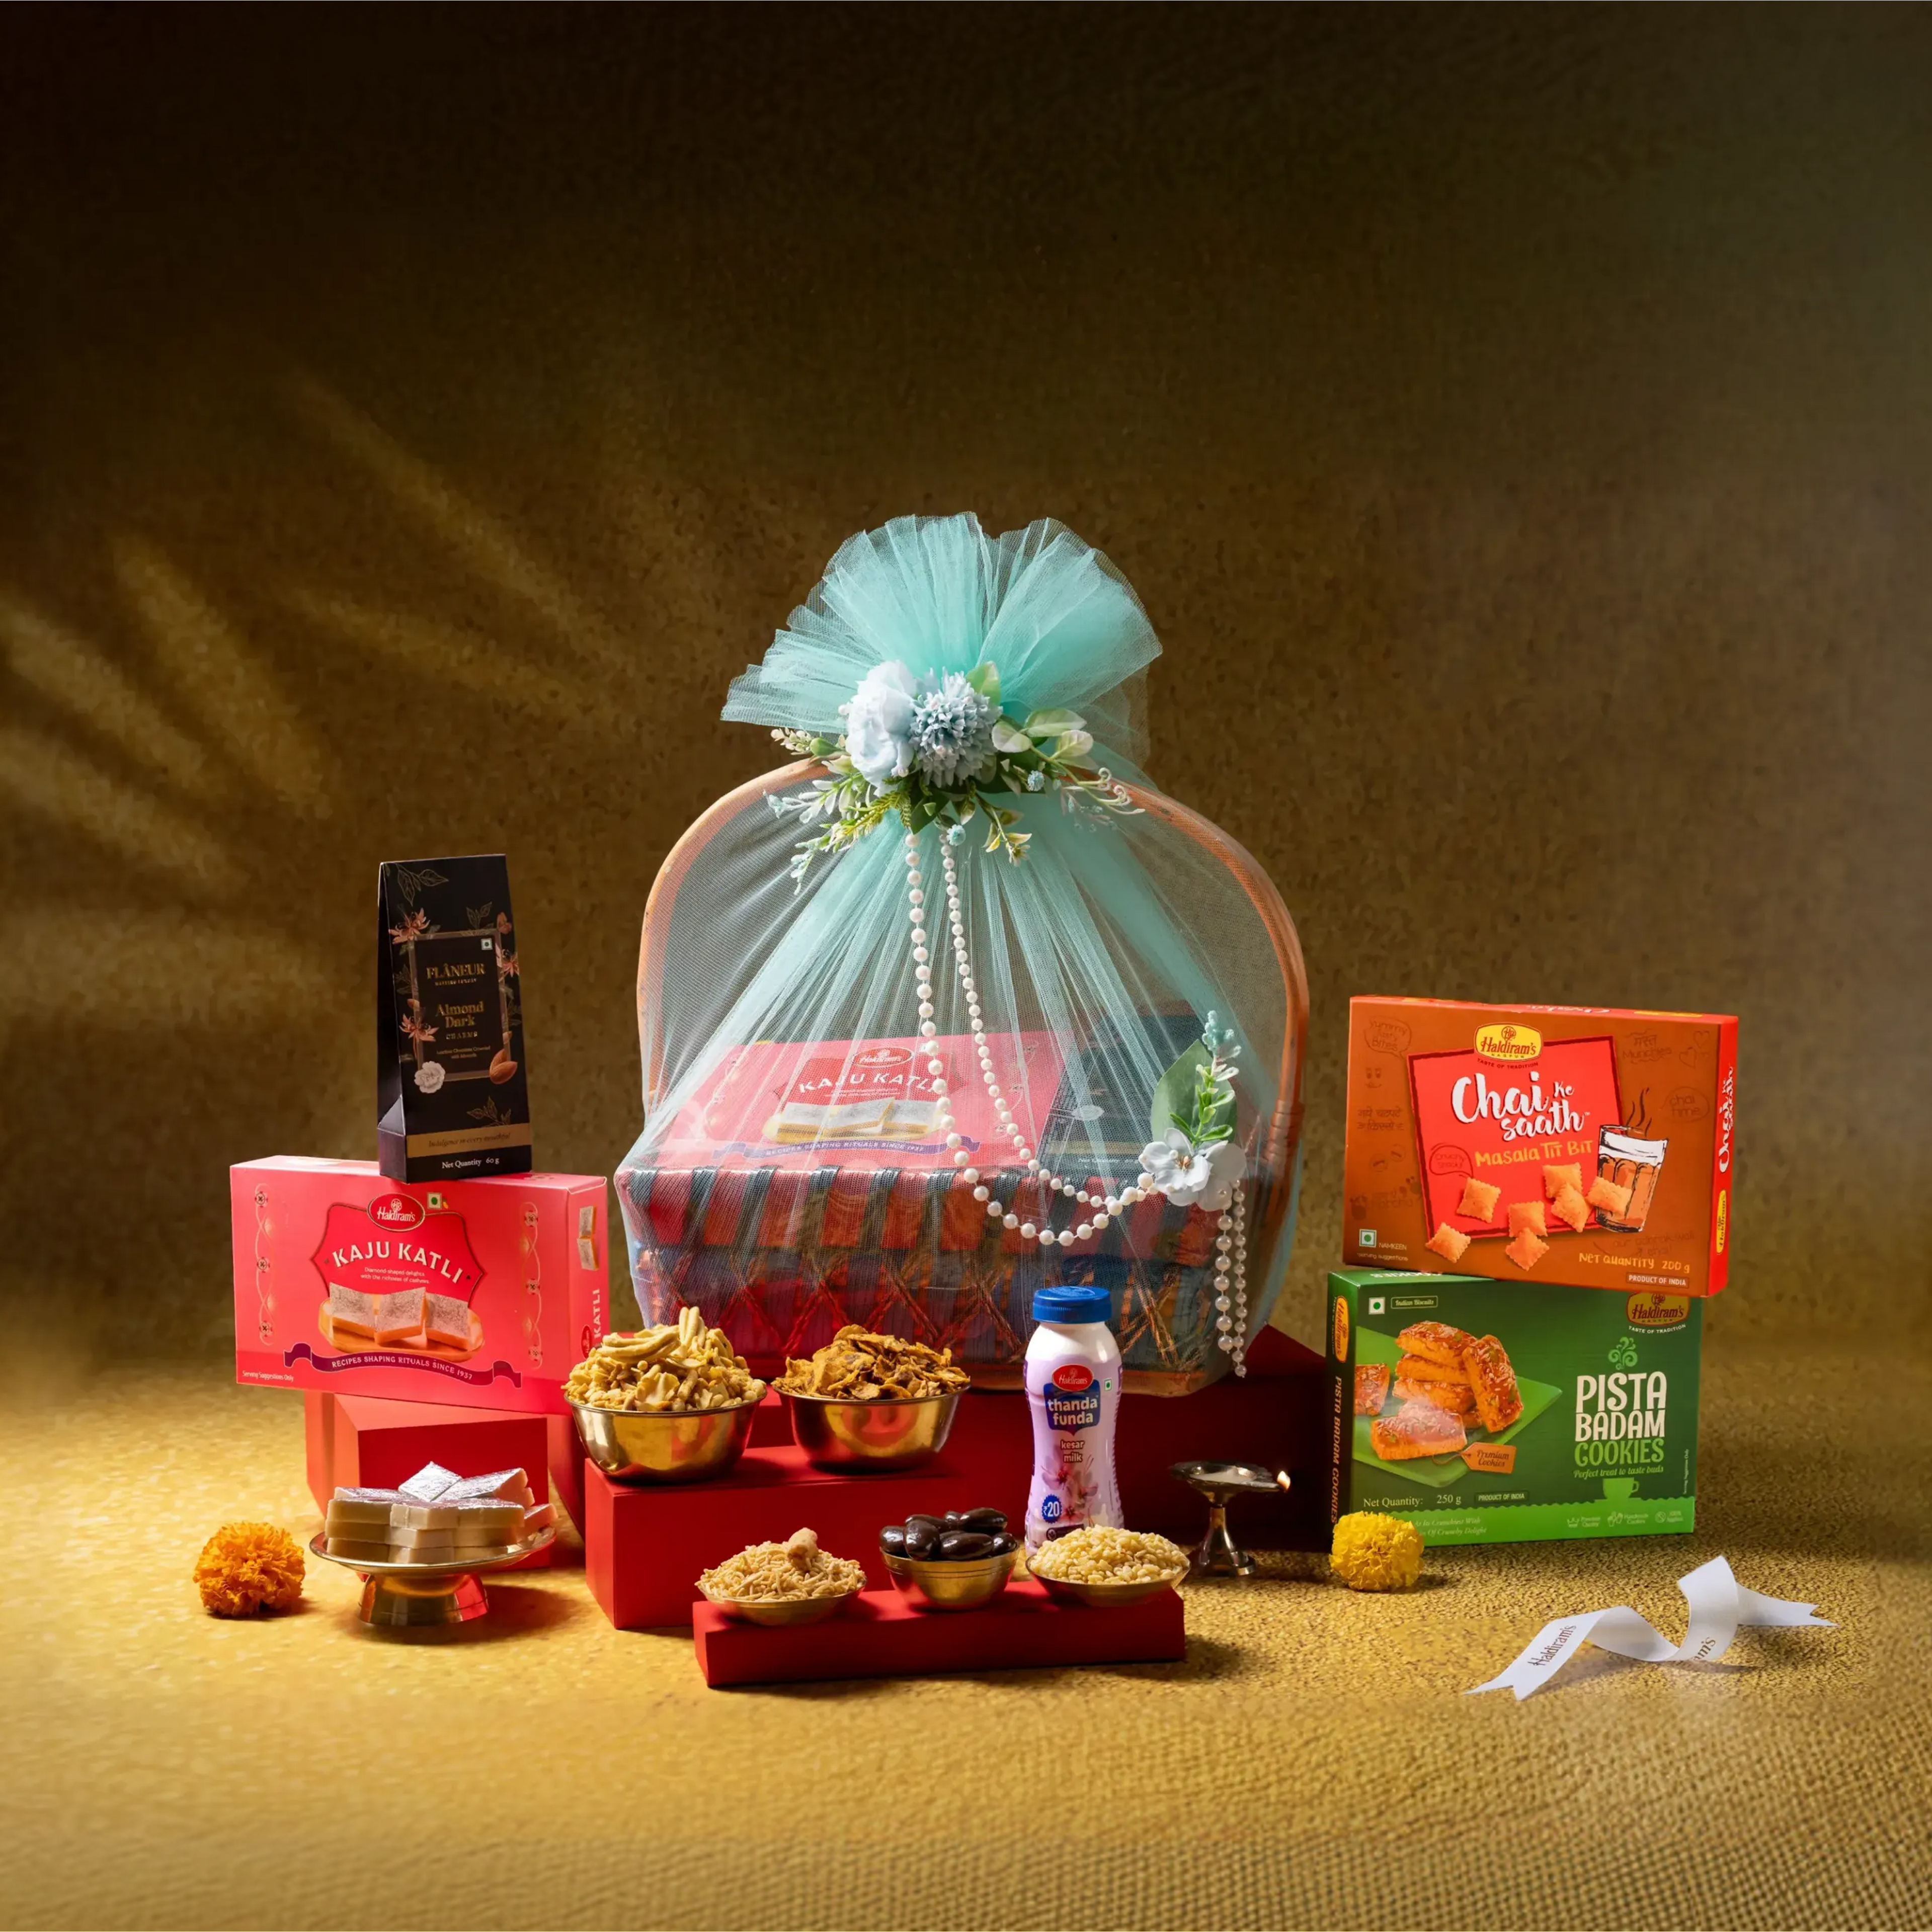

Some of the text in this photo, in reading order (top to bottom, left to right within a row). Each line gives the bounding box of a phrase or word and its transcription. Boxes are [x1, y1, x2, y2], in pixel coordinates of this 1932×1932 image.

[437, 1001, 485, 1016] Almond
[445, 1015, 475, 1028] Dark
[1480, 1036, 1537, 1055] Haldiram's
[1477, 1058, 1494, 1068] TASTE
[799, 1073, 865, 1093] KAJU
[1452, 1071, 1549, 1123] Chai
[1500, 1099, 1584, 1141] saath
[455, 1158, 482, 1168] Quantity
[377, 1206, 415, 1222] Haldiram's
[332, 1241, 463, 1283] KAJU KATLI
[1662, 1260, 1681, 1271] 200
[1684, 1264, 1690, 1274] g
[365, 1267, 425, 1277] Diamond-shaped delights
[1629, 1274, 1657, 1283] PRODUCT
[1668, 1278, 1686, 1286] INDIA
[592, 1288, 601, 1339] KATLI
[1632, 1304, 1684, 1319] Haldiram's
[1629, 1325, 1646, 1333] TASTE
[1656, 1324, 1686, 1333] TRADITION
[332, 1356, 361, 1368] RECIPES
[398, 1356, 430, 1366] RITUALS
[432, 1361, 455, 1374] SINCE
[457, 1369, 473, 1380] 1937
[243, 1370, 294, 1383] Serving Suggestions Only
[1059, 1375, 1087, 1385] Haldiram's
[1576, 1371, 1667, 1413] PISTA
[1048, 1397, 1097, 1411] thanda
[1053, 1411, 1093, 1425] funda
[1575, 1410, 1665, 1441] BADAM
[1061, 1440, 1084, 1449] kesar
[1064, 1453, 1082, 1462] milk
[1477, 1449, 1509, 1460] Premium
[1575, 1438, 1664, 1467] COOKIES
[1479, 1458, 1505, 1467] Cookies
[1573, 1470, 1598, 1480] Perfect
[1600, 1468, 1617, 1477] treat
[1628, 1467, 1645, 1475] taste
[1647, 1465, 1663, 1473] buds
[1331, 1468, 1339, 1523] COOKIES
[1363, 1494, 1462, 1508] Net Quantity: 250 g
[1465, 1526, 1487, 1536] Delight
[1527, 1626, 1576, 1666] Haldiram's
